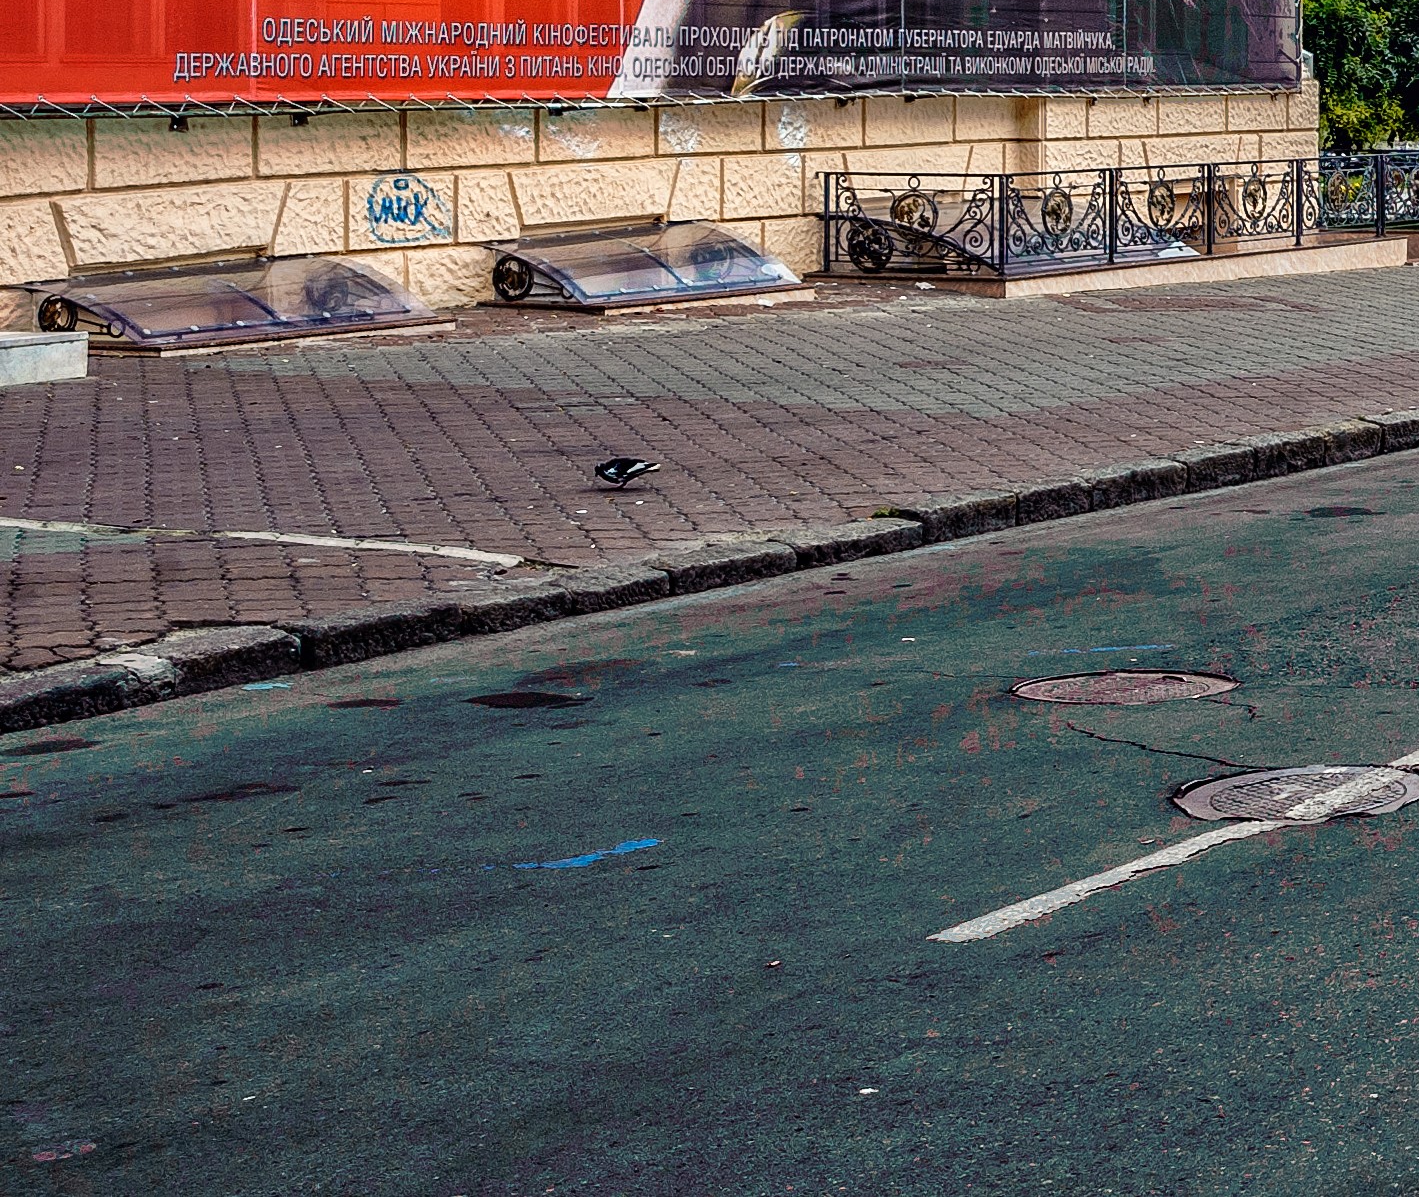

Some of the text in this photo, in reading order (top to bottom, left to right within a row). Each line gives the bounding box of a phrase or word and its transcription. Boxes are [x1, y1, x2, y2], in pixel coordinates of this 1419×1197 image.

[262, 16, 1116, 52] ОДЕСЬКИЙ МІЖНАРОДНИЙ КІНОФЕСТИВАЛЬ ПРОХОДИТЬ ПІД ПАТРОНАТОМ ГУБЕРНАТОРА ЕДУАРДА МАТВІЙЧУКА,
[174, 52, 312, 81] ДЕРЖАВНОГО
[317, 54, 423, 78] АГЕНТСТВА
[427, 50, 500, 78] УКРАЇНИ
[504, 55, 516, 78] З
[520, 55, 583, 78] ПИТАНЬ
[587, 56, 628, 81] КІНО,
[632, 53, 704, 81] ОДЕСЬКОЇ
[708, 54, 776, 78] ОБЛАСНОЇ
[778, 53, 856, 79] ДЕРЖАВНОЇ
[859, 53, 946, 79] АДМІНІСТРАЦІЇ
[948, 57, 964, 75] ТА
[965, 57, 1032, 75] ВИКОНКОМУ
[1034, 53, 1085, 78] ОДЕСЬКОЇ
[1086, 53, 1127, 75] МІСЬКОЇ
